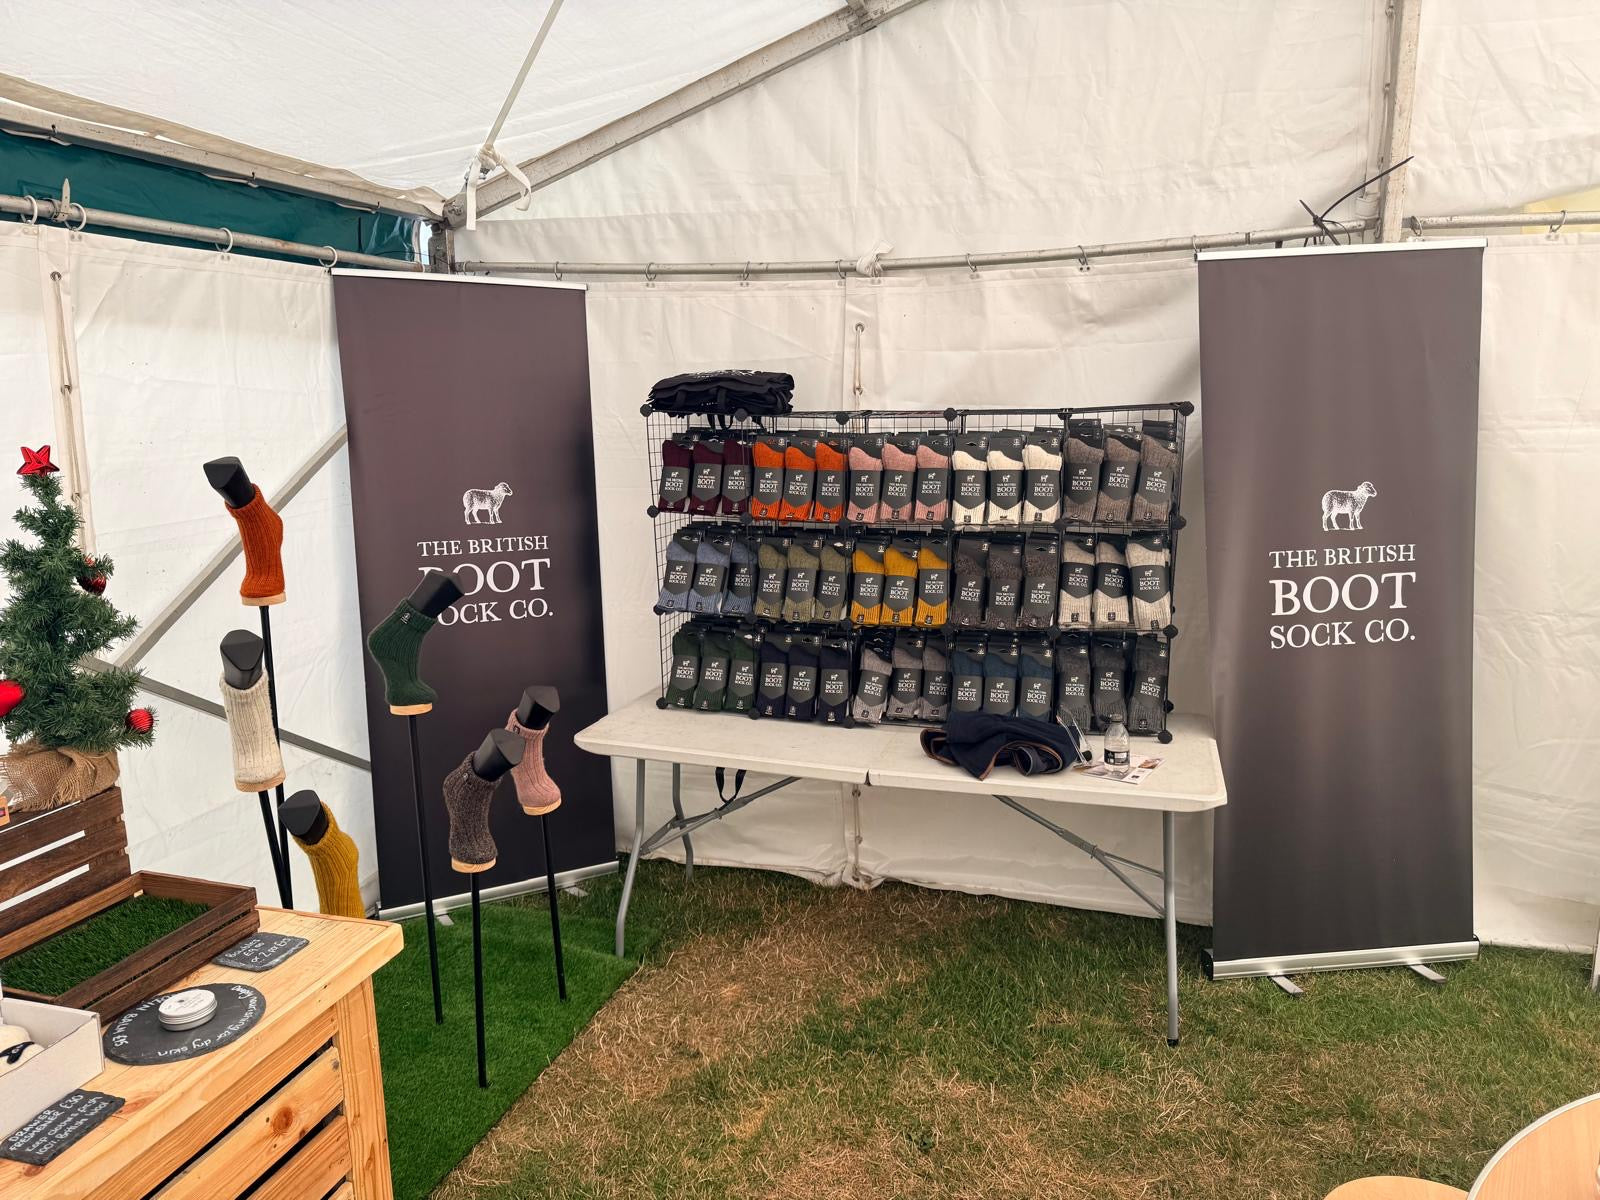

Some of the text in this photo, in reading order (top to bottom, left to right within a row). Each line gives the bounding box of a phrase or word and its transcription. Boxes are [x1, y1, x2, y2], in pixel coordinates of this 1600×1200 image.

[1146, 481, 1167, 489] BOOT
[417, 536, 548, 556] THE BRITISH
[1269, 544, 1416, 568] THE BRITISH
[418, 558, 550, 596] OOT
[1269, 572, 1416, 616] BOOT
[437, 598, 553, 626] OCK CO.
[1269, 618, 1415, 649] SOCK CO.
[864, 684, 882, 693] BOOT
[1141, 685, 1160, 694] BOOT
[158, 1046, 188, 1057] skin
[192, 1038, 212, 1048] dry
[60, 1094, 83, 1109] £30
[9, 1109, 54, 1142] DRAWER
